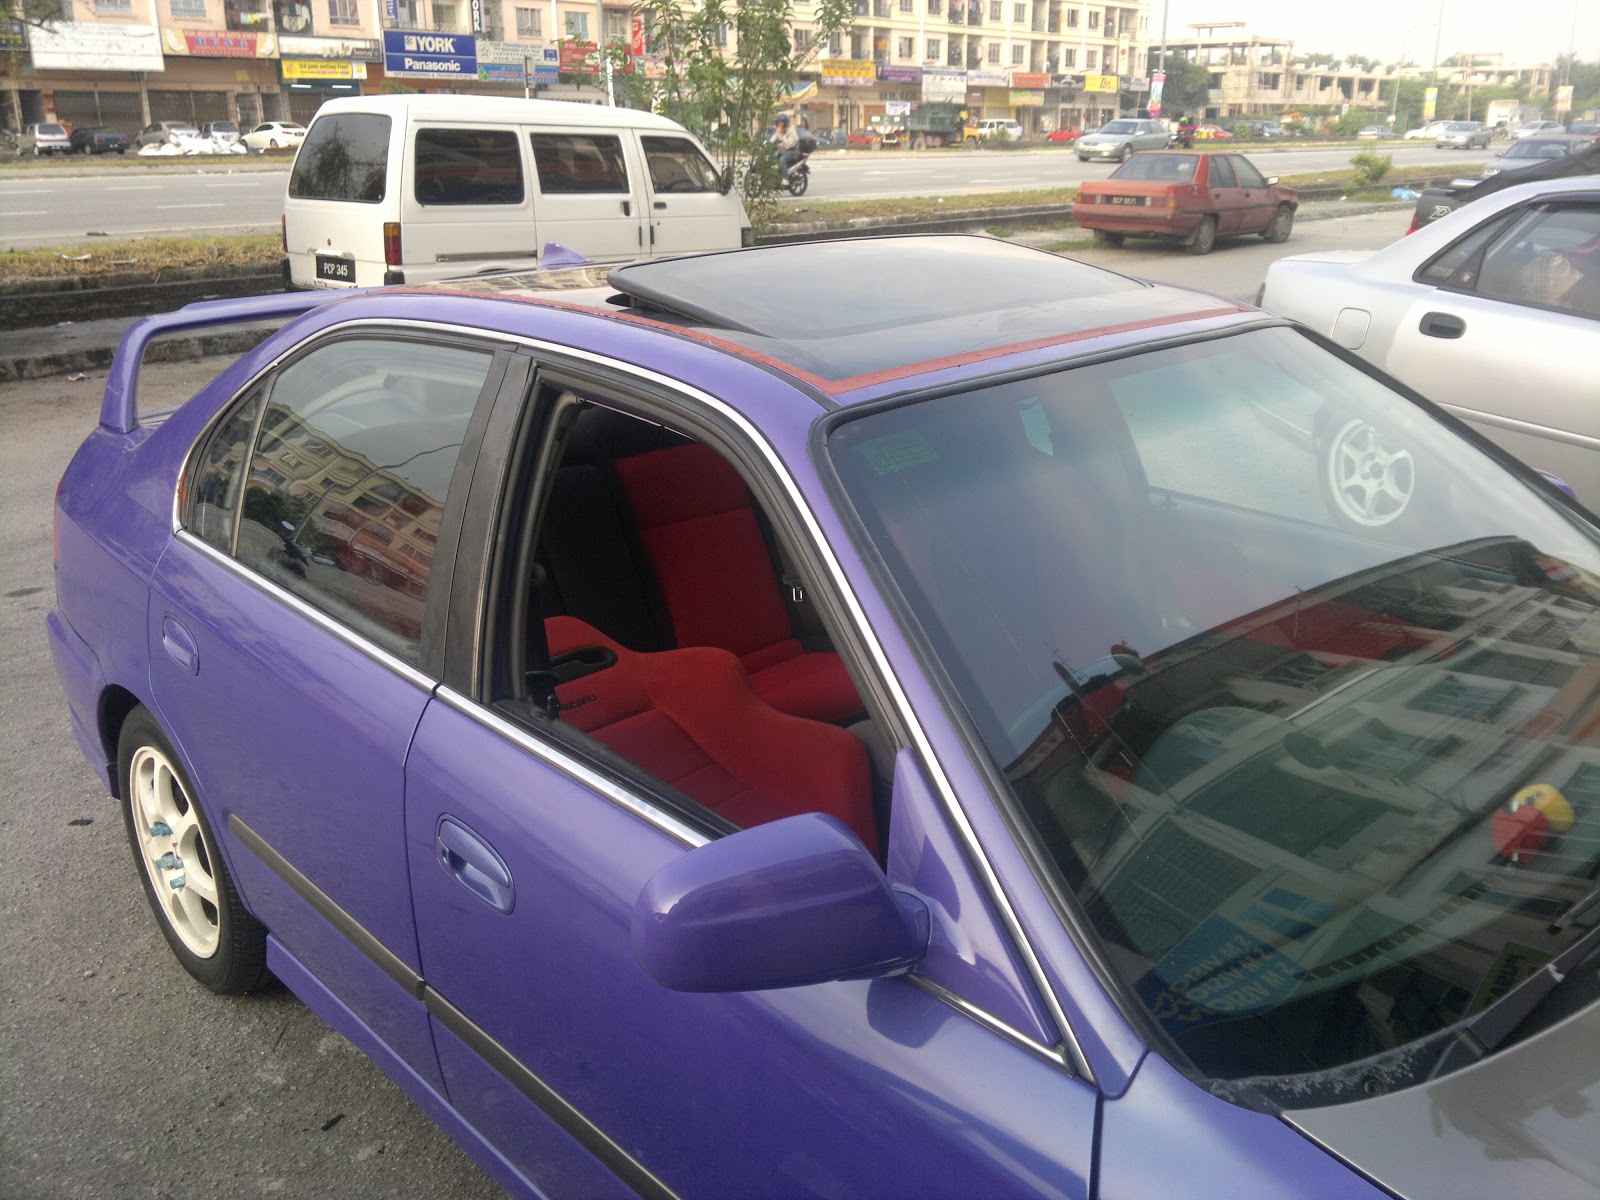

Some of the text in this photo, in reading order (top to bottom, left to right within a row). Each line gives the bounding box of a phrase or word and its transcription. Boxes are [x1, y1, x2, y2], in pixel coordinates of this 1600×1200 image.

[416, 36, 456, 53] YORK
[404, 57, 461, 71] Panasonic
[323, 262, 348, 277] PCP 345
